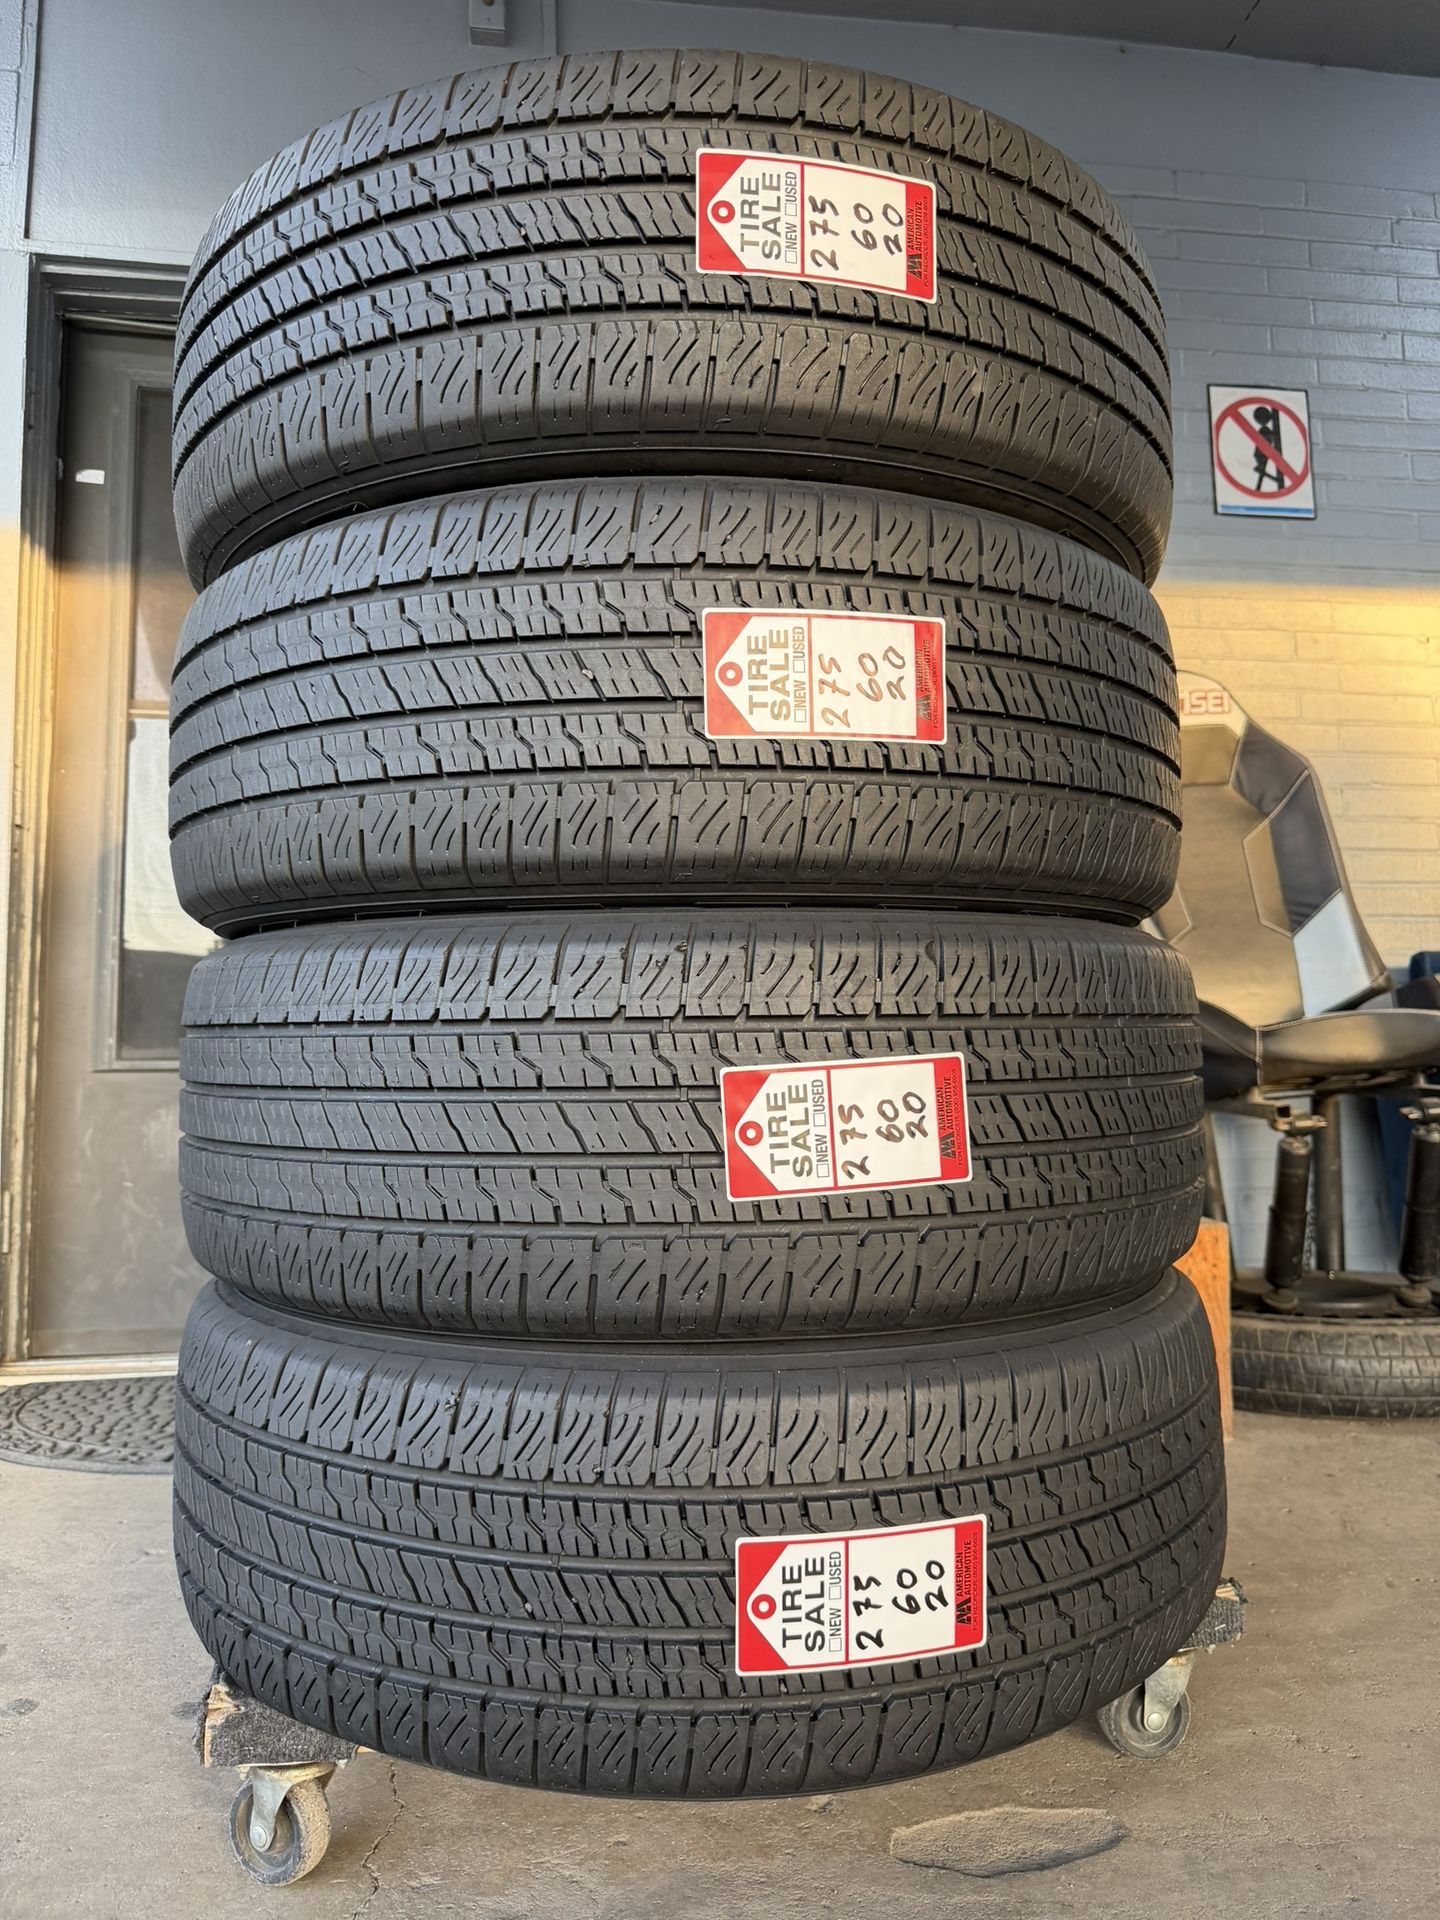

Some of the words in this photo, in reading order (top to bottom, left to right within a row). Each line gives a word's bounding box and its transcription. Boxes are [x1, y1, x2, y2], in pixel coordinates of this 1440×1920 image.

[786, 172, 796, 202] USED
[741, 176, 759, 252] TIRE
[762, 172, 782, 260] SALE
[786, 222, 797, 250] NEW
[808, 195, 840, 271] 275
[852, 202, 878, 250] 60
[882, 203, 904, 256] 20
[793, 626, 805, 659] USED
[747, 635, 768, 715] TIRE
[769, 629, 790, 721] SALE
[794, 680, 806, 708] NEW
[818, 654, 850, 728] 275
[856, 653, 882, 702] 60
[883, 646, 906, 701] 20
[812, 1079, 825, 1112] USED
[876, 1099, 904, 1143] 60
[902, 1091, 928, 1140] 20
[937, 1087, 946, 1130] AMERICAN
[944, 1076, 954, 1130] AUTOMOTIVE
[766, 1092, 790, 1174] TIRE
[787, 1084, 813, 1178] SALE
[816, 1134, 830, 1162] NEW
[838, 1103, 871, 1179] 275
[829, 1551, 842, 1584] USED
[892, 1568, 921, 1614] 60
[925, 1560, 949, 1612] 20
[782, 1565, 802, 1648] TIRE
[804, 1557, 825, 1651] SALE
[829, 1608, 842, 1636] NEW
[853, 1575, 884, 1650] 275
